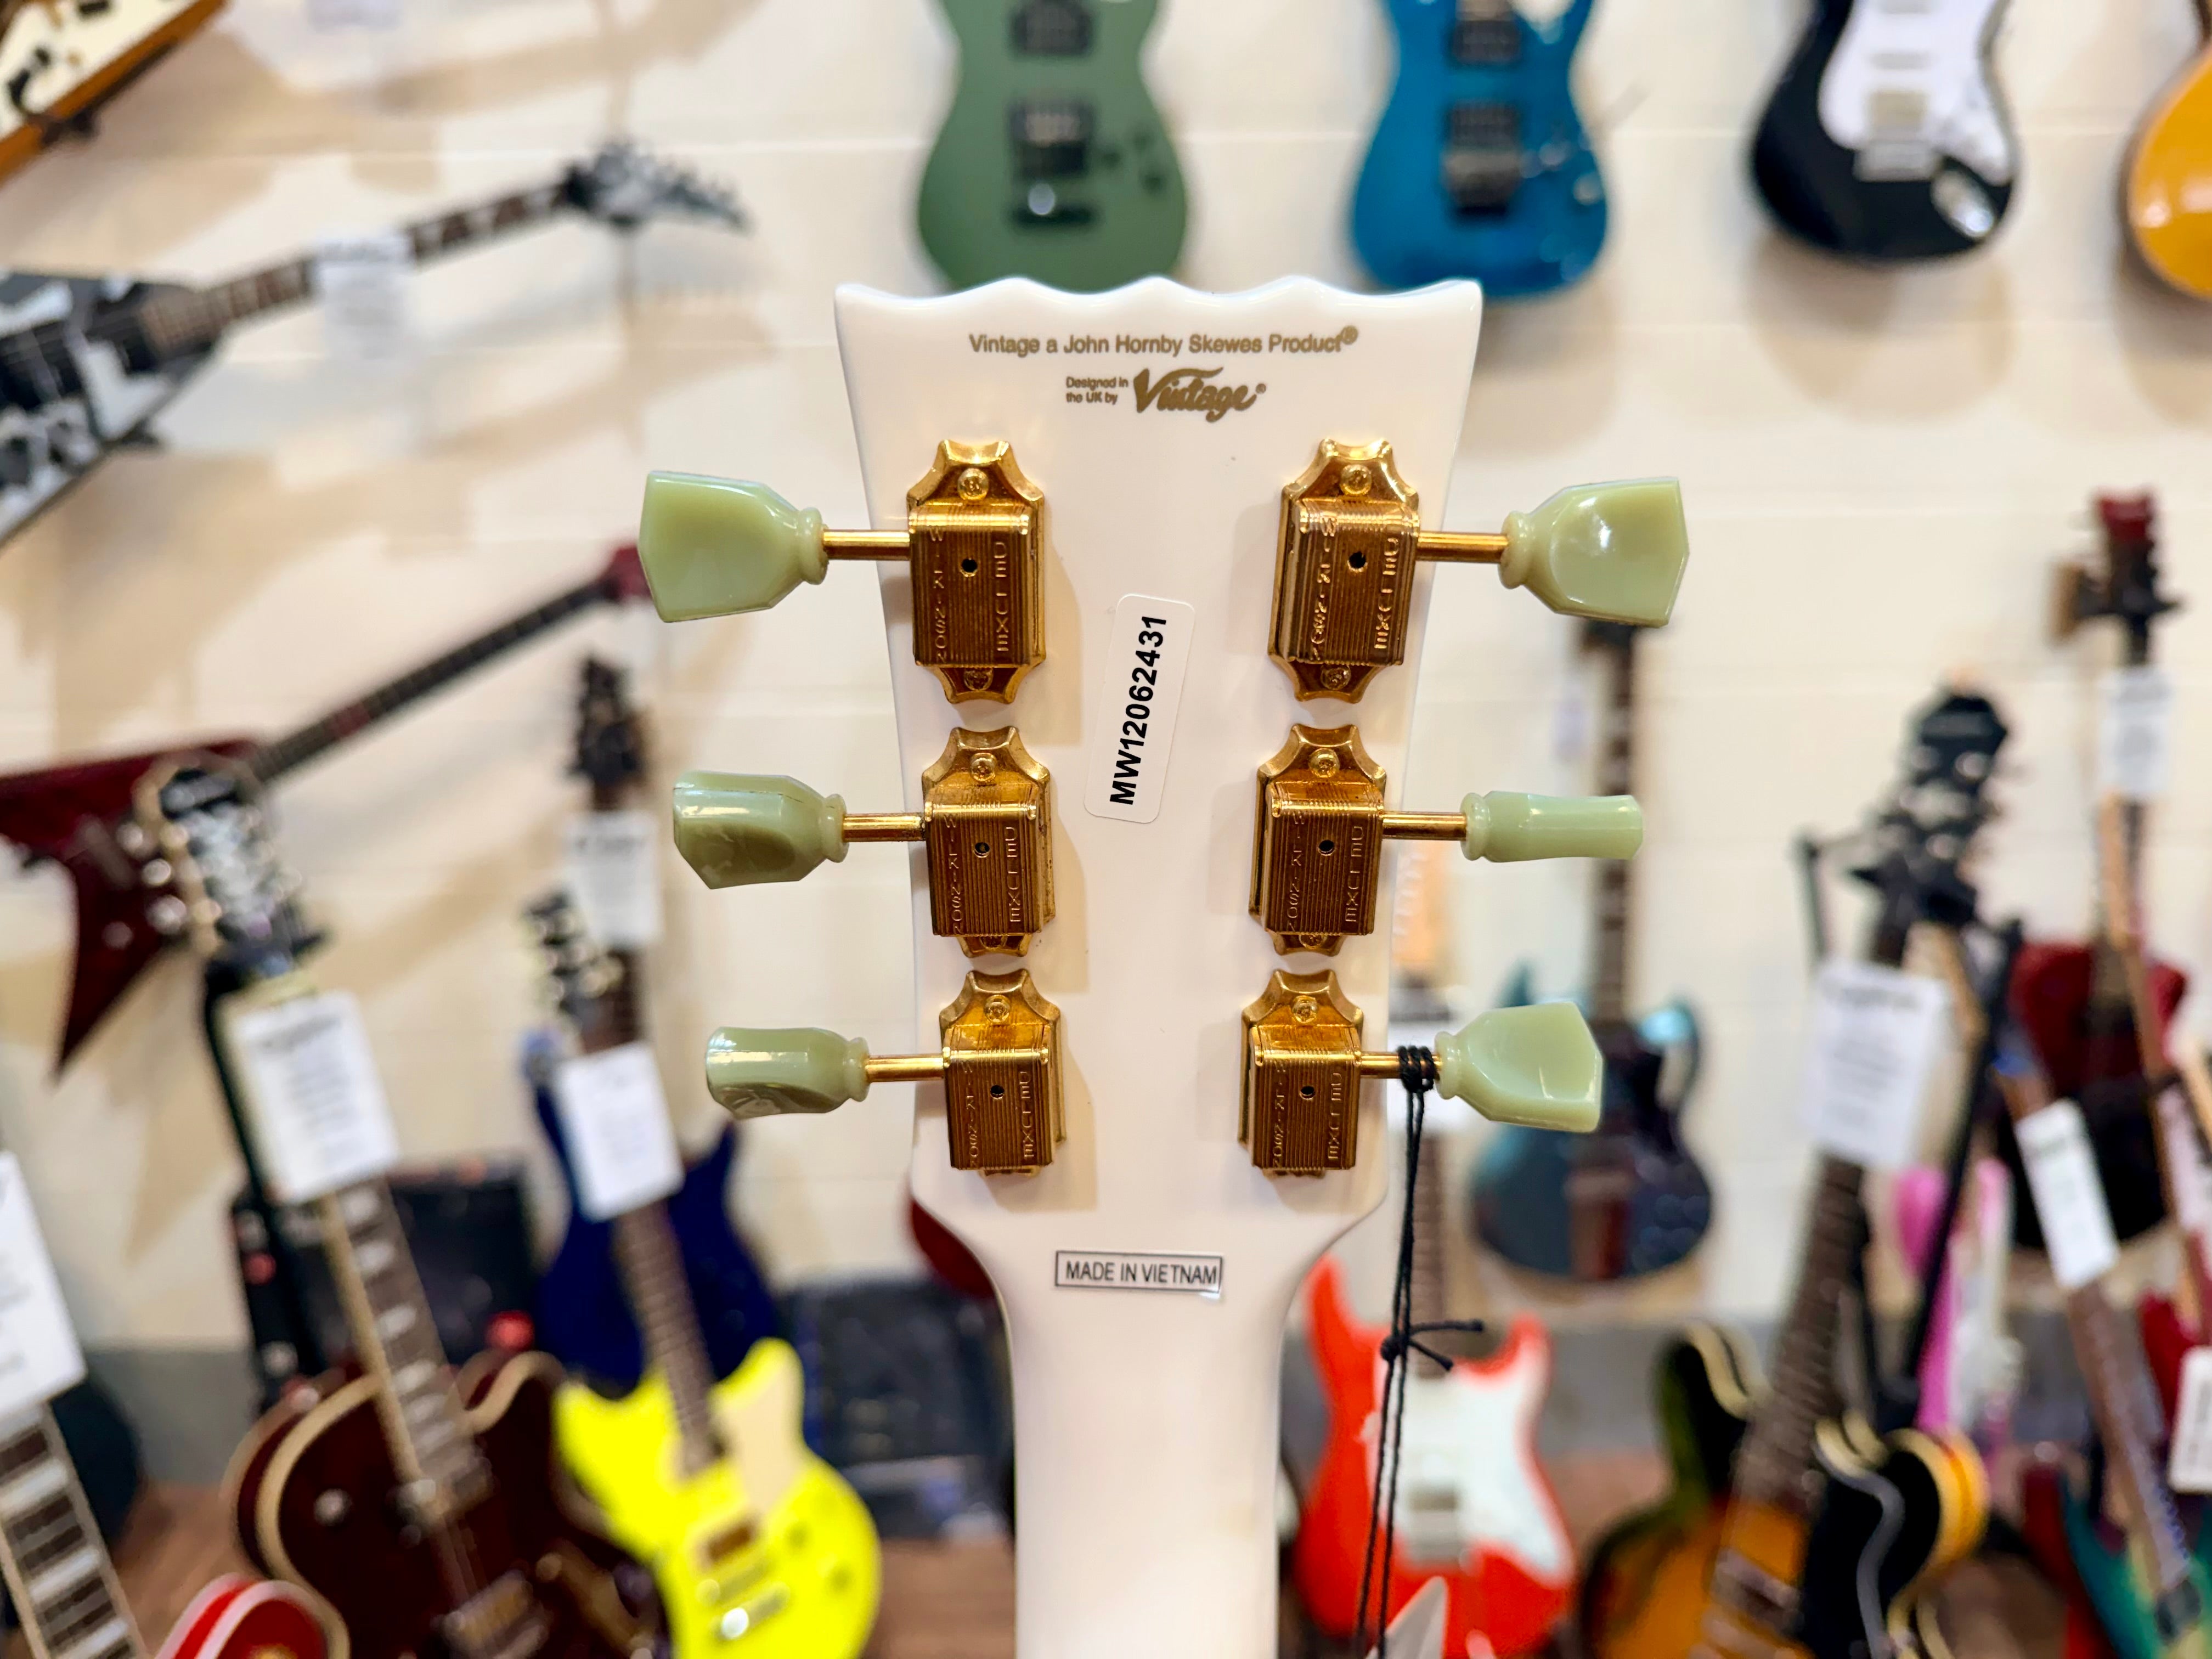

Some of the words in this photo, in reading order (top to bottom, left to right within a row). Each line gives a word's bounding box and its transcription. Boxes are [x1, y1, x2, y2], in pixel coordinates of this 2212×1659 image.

[969, 334, 1040, 357] Vintage
[1046, 338, 1058, 353] a
[1064, 335, 1109, 353] John
[1116, 335, 1182, 357] Hornby
[1189, 334, 1262, 353] Skewes
[1066, 376, 1116, 391] Designed
[1119, 377, 1129, 388] in
[1066, 392, 1083, 403] the
[1086, 392, 1102, 403] UK
[1104, 392, 1118, 405] by
[1109, 616, 1167, 805] MW12062431
[1065, 1260, 1115, 1282] MADE
[1120, 1263, 1137, 1282] IN
[1141, 1263, 1217, 1285] VIETNAM
